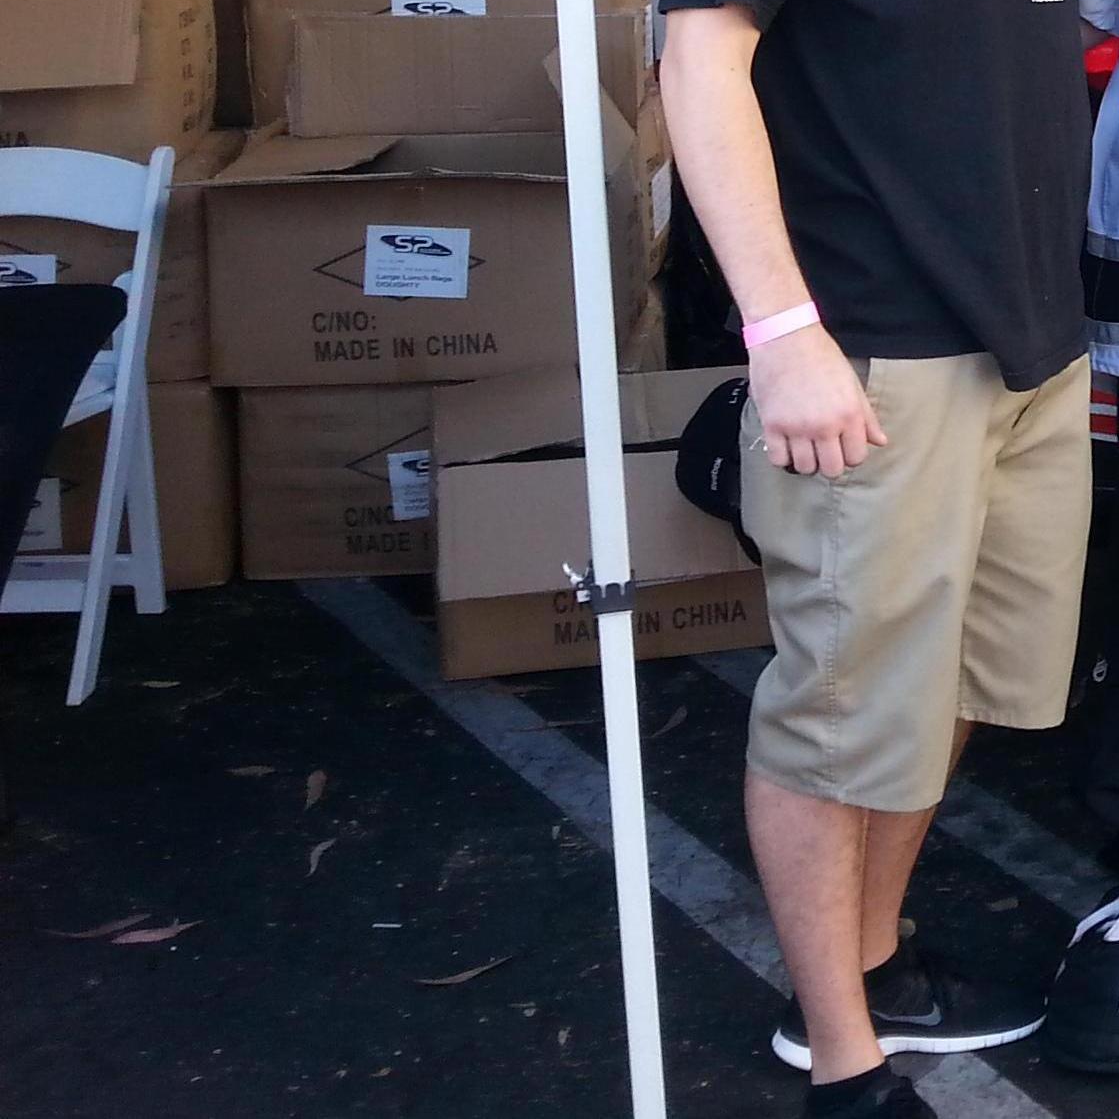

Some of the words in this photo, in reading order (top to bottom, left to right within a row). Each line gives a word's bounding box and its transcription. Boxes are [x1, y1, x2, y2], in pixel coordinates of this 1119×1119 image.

[312, 311, 376, 333] C/NO:
[315, 339, 380, 362] MADE
[393, 336, 415, 358] IN
[426, 332, 498, 356] CHINA
[346, 532, 411, 554] MADE
[554, 619, 599, 645] MA
[637, 611, 660, 634] IN
[673, 599, 747, 630] CHINA
